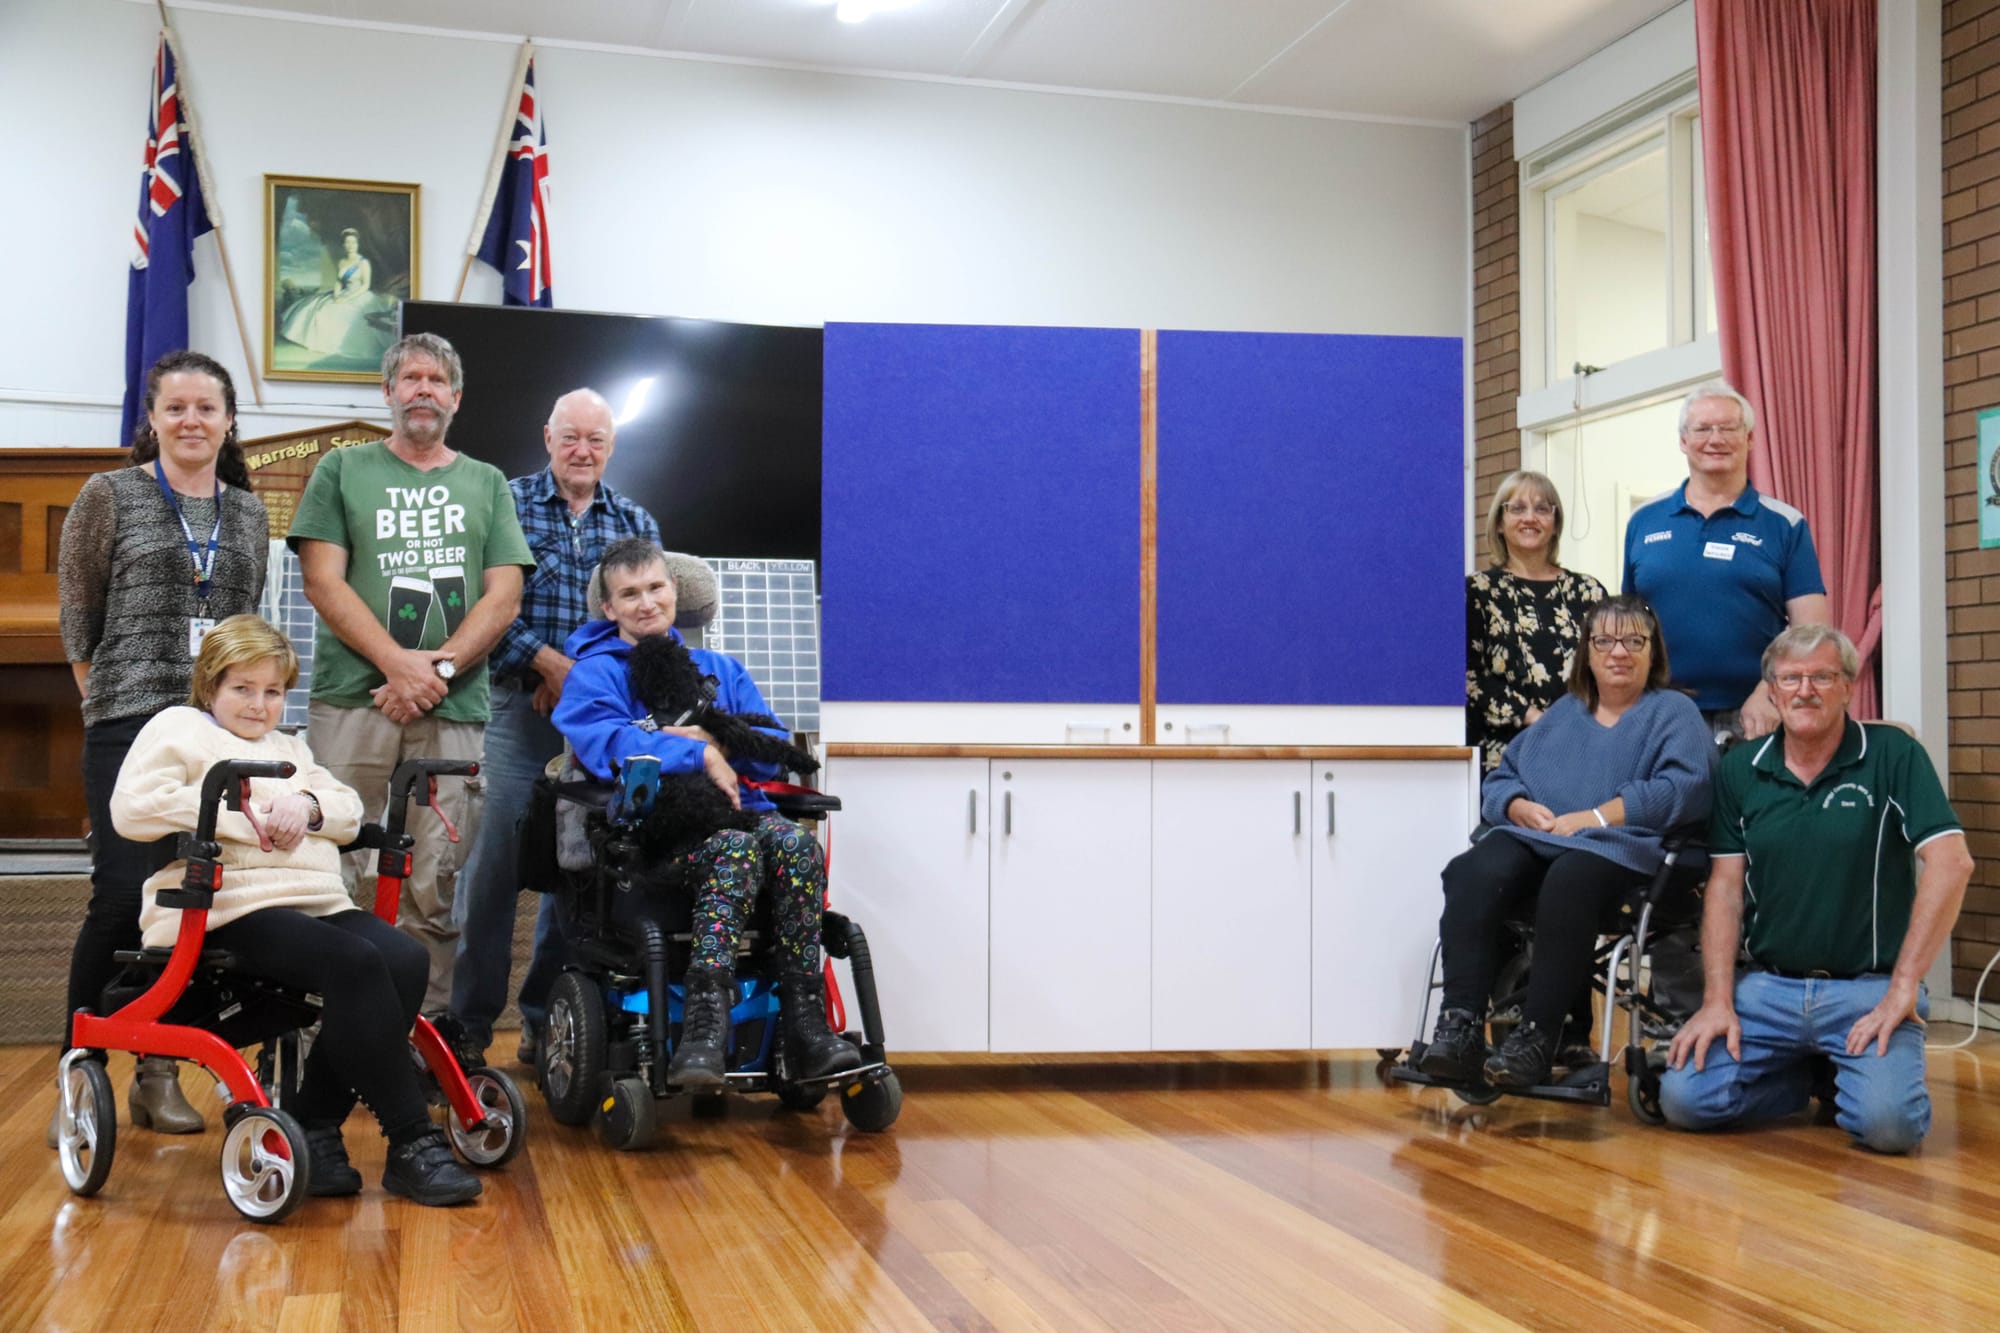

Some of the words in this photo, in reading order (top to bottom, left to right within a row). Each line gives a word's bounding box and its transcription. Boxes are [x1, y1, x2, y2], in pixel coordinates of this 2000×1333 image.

[246, 439, 320, 470] Warragul
[385, 485, 449, 509] TWO
[376, 504, 466, 540] BEER
[406, 540, 421, 549] OR
[423, 538, 444, 548] NOT
[377, 550, 419, 570] TWO
[423, 546, 466, 565] BEER
[727, 561, 761, 571] BLACK
[771, 562, 811, 572] YELLOW
[709, 622, 720, 633] 4
